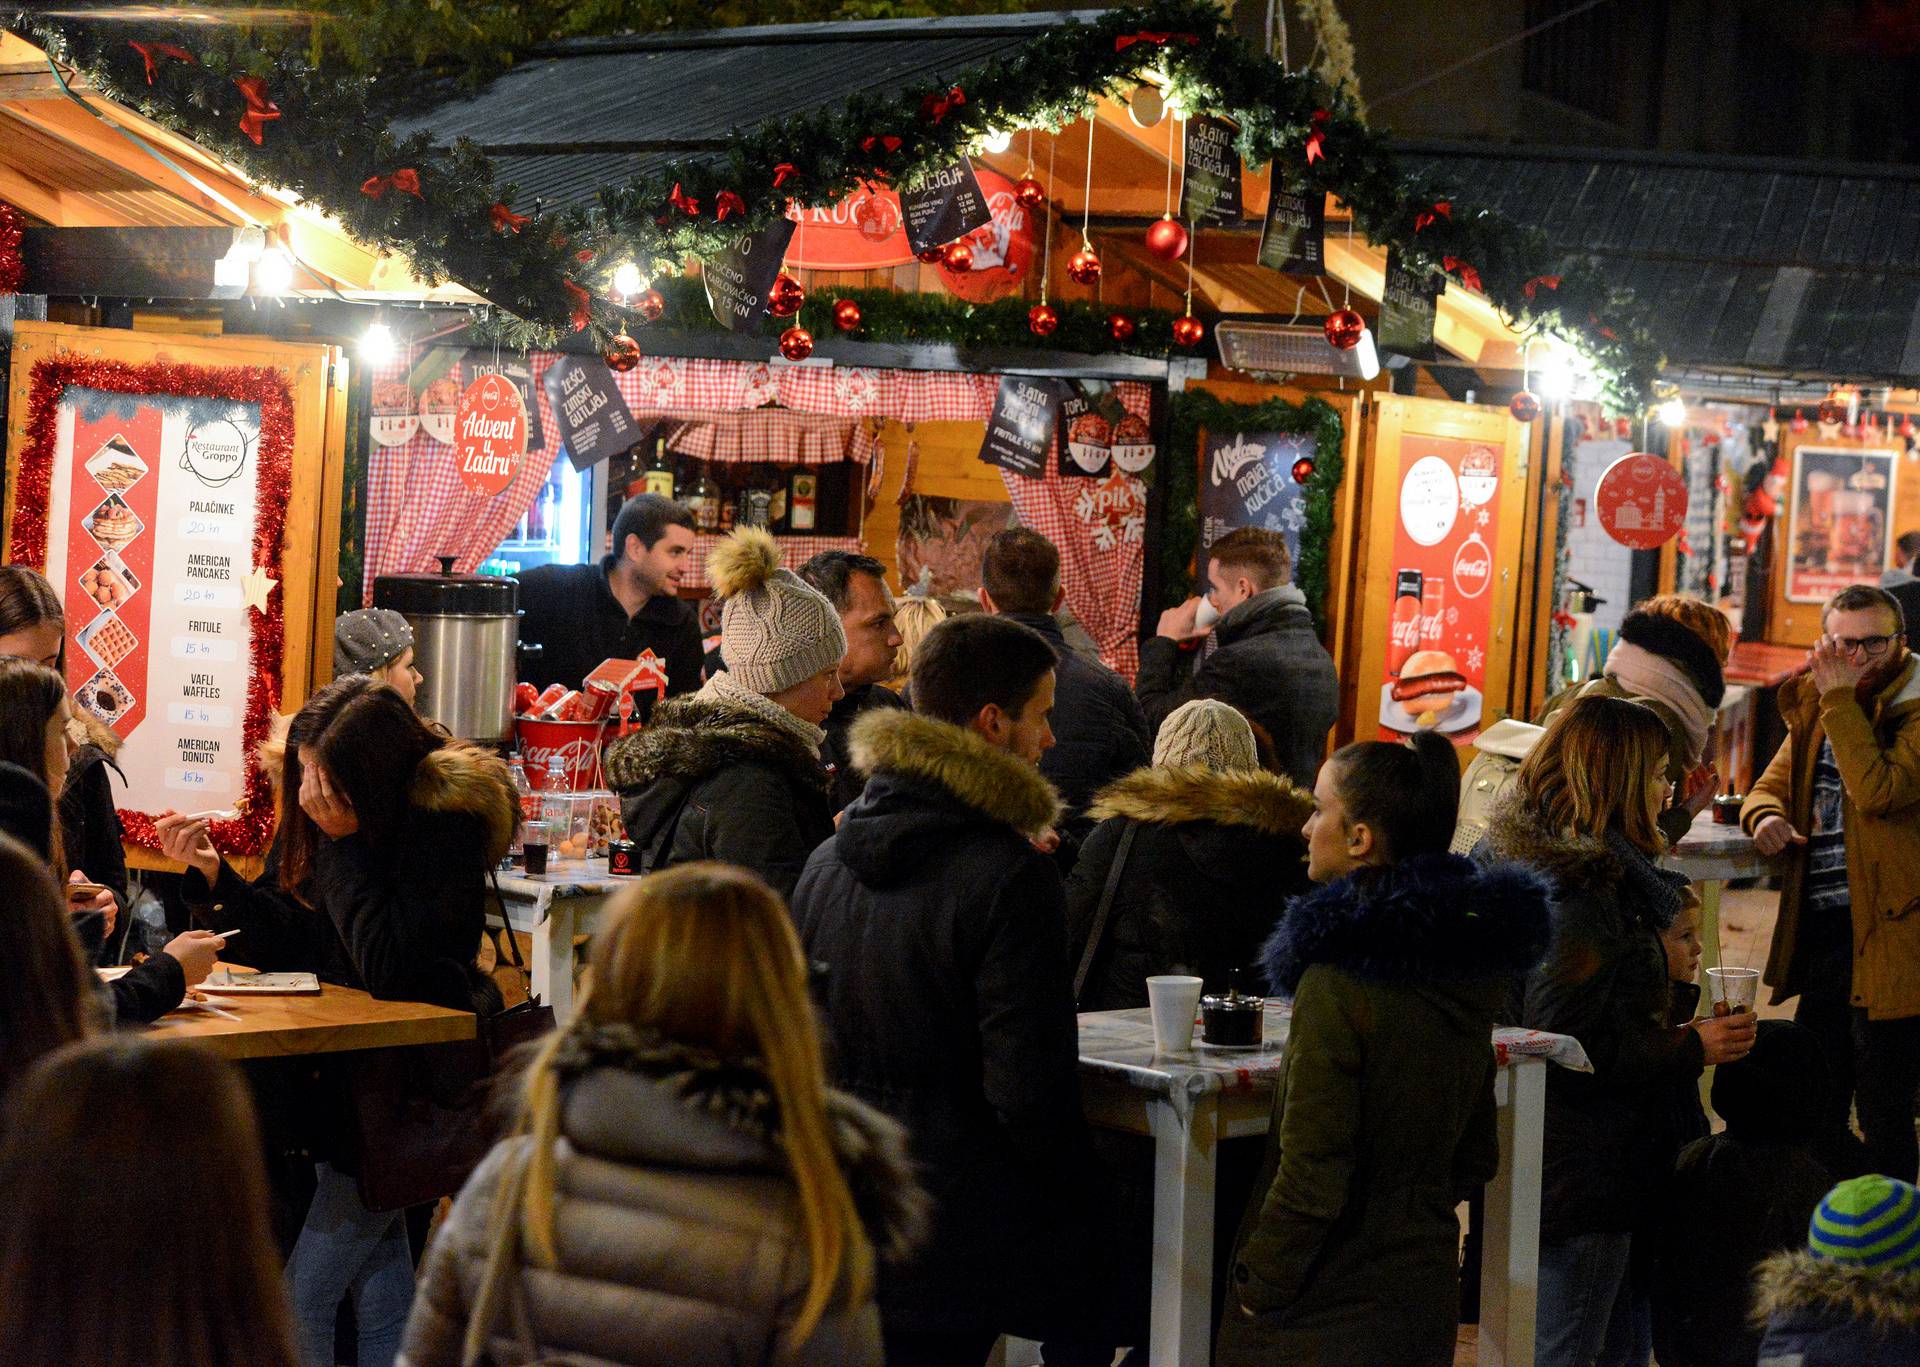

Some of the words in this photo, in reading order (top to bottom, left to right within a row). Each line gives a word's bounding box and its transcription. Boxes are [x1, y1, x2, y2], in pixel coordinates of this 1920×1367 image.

[733, 303, 750, 319] KN
[462, 411, 516, 440] Advent
[993, 427, 1022, 446] FRITULE
[191, 441, 240, 453] Restaurant
[483, 440, 492, 453] u
[202, 451, 238, 463] Groppo
[463, 446, 511, 476] Zadru
[189, 500, 236, 515] PALAČINKE
[187, 521, 206, 534] 20
[188, 554, 231, 567] AMERICAN
[187, 567, 230, 580] PANCAKES
[184, 589, 201, 601] 20
[189, 620, 222, 633] FRITULE
[186, 642, 198, 654] 15
[191, 673, 214, 686] VAFLI
[183, 686, 220, 699] WAFFLES
[184, 708, 196, 720] 15
[178, 738, 220, 752] AMERICAN
[182, 751, 215, 764] DONUTS
[183, 771, 195, 783] 15
